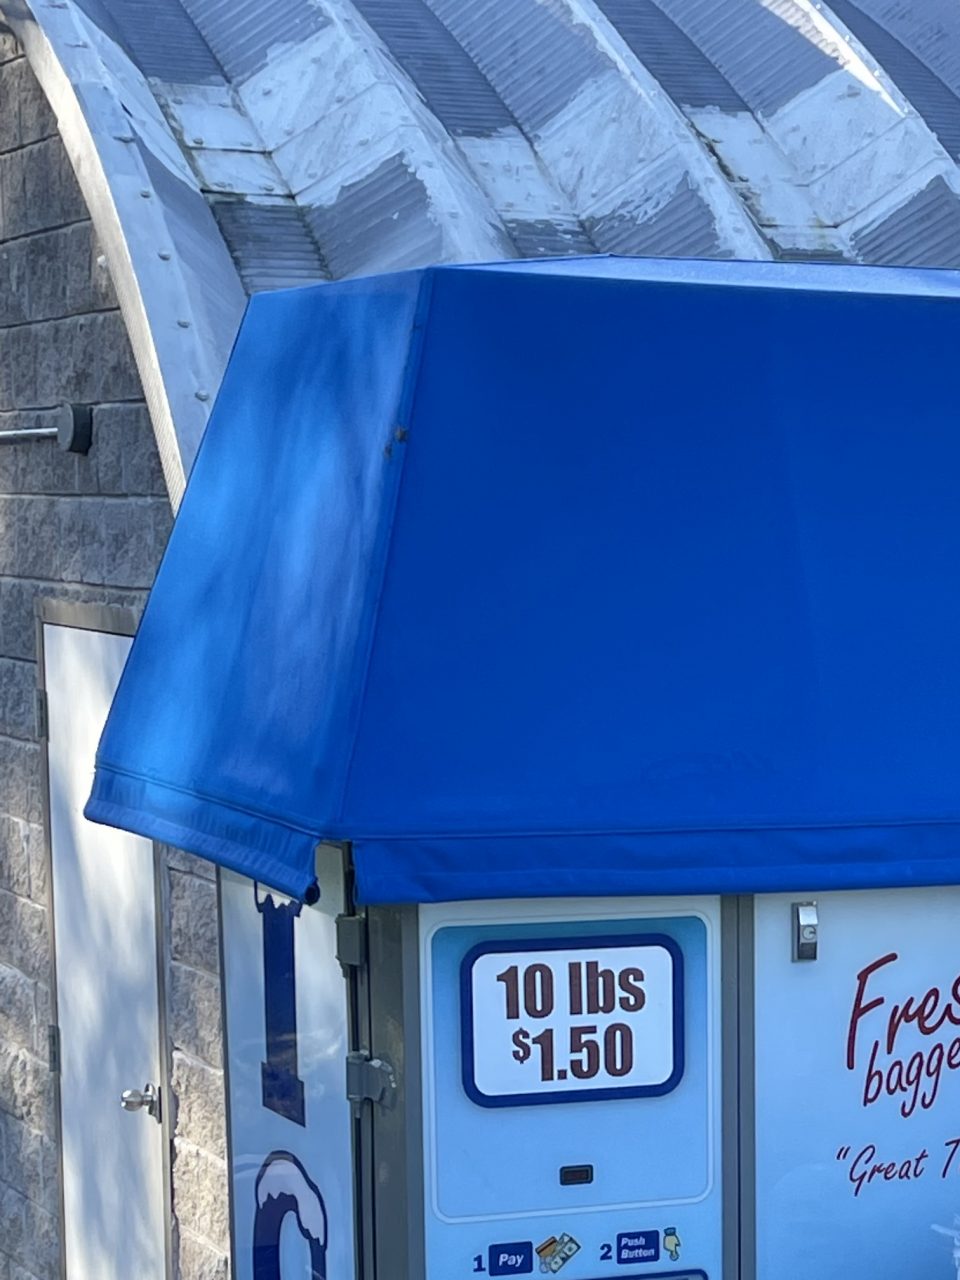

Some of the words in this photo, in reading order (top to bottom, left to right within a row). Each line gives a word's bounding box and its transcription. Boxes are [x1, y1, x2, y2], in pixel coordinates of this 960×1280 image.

[496, 963, 554, 1020] 10
[569, 961, 646, 1015] lbs
[512, 1023, 633, 1082] $1.50
[600, 1244, 612, 1260] 2
[621, 1236, 646, 1247] Push
[621, 1248, 655, 1259] Button
[473, 1255, 486, 1272] 1
[498, 1252, 524, 1267] Pay
